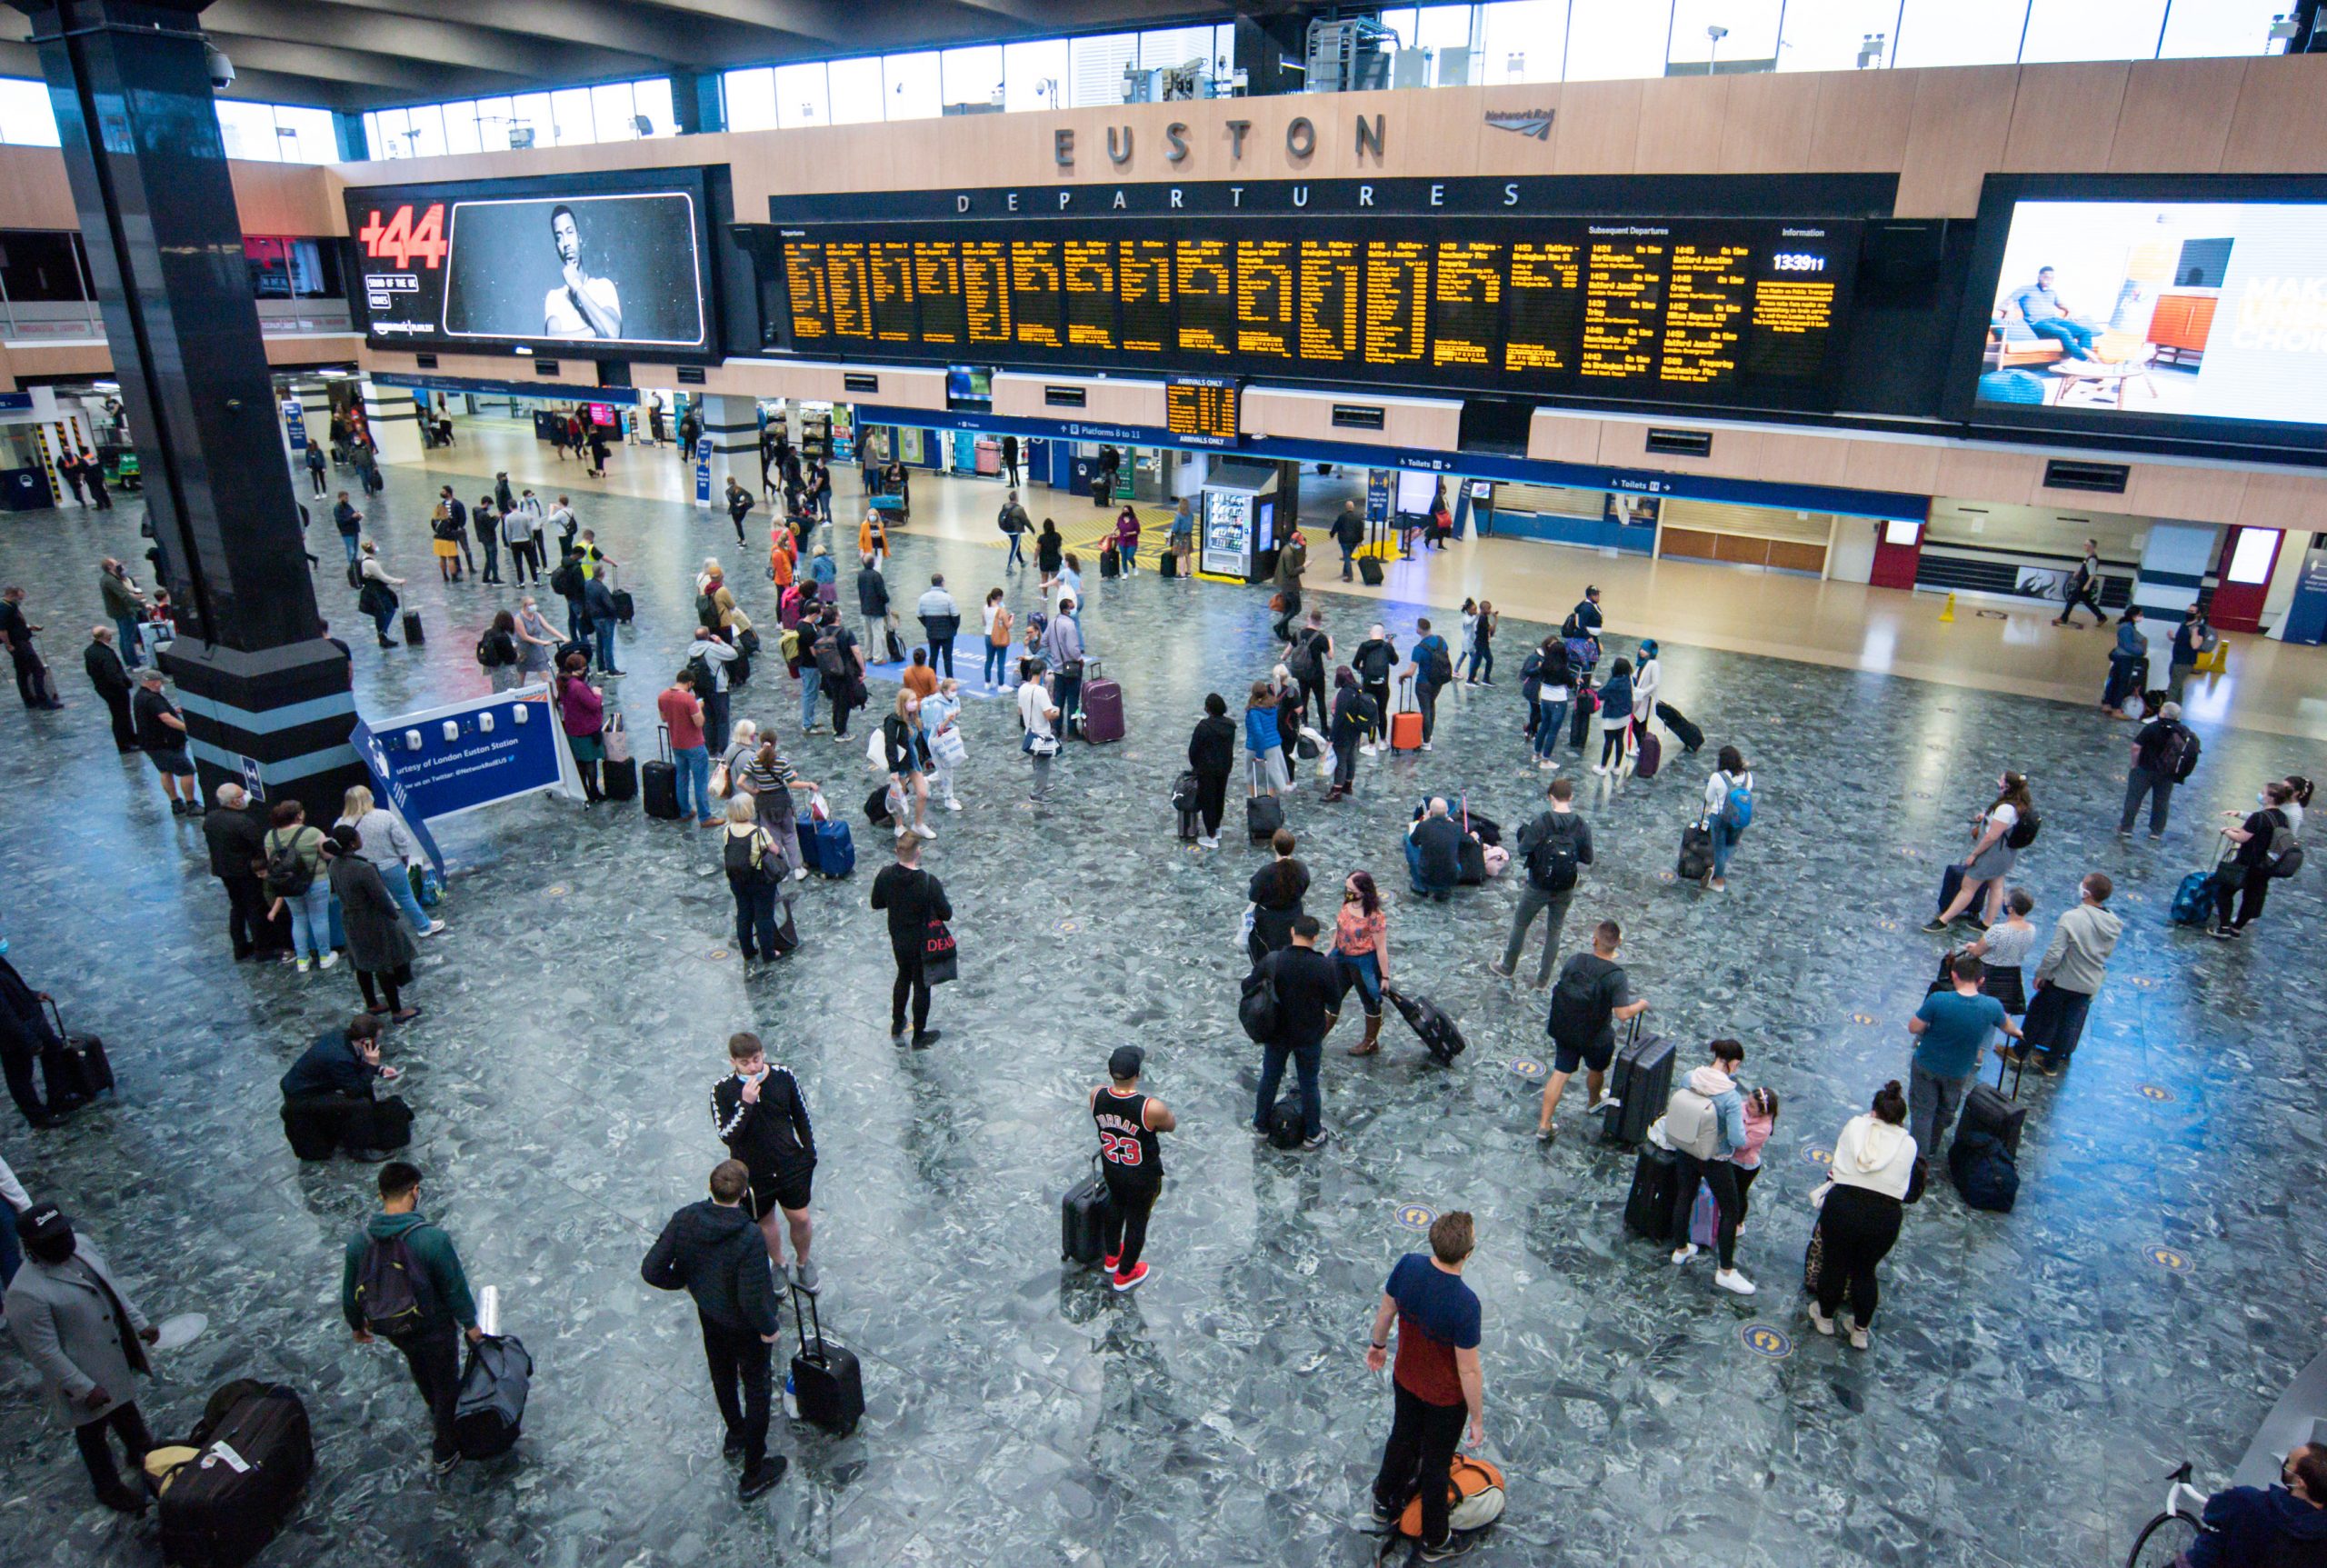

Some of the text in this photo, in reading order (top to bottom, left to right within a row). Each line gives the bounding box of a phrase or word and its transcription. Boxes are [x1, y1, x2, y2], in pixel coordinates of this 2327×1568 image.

[1054, 114, 1385, 165] EUSTON
[958, 183, 1519, 212] DEPARTURES
[1589, 226, 1668, 235] Subsequent Departures
[1783, 228, 1824, 237] Information
[360, 203, 447, 269] +44
[1544, 245, 1573, 253] Platform
[1593, 245, 1663, 254] 1424 On time
[1733, 247, 1749, 255] time
[1644, 274, 1659, 282] time
[1717, 275, 1727, 284] On
[386, 278, 394, 288] OF
[395, 278, 406, 288] THE
[1670, 284, 1693, 292] Crewe
[1630, 301, 1640, 309] On
[1669, 303, 1689, 311] 1452
[1725, 305, 1741, 313] time
[1587, 308, 1604, 317] Tring
[1639, 328, 1653, 336] time
[1711, 332, 1721, 340] On
[1723, 333, 1738, 341] time
[1636, 355, 1651, 364] time
[1081, 427, 1114, 436] Platforms
[1122, 430, 1130, 438] to
[1407, 457, 1431, 469] Toilets
[1621, 479, 1647, 491] Toilets
[396, 737, 518, 775] urtesy of London Euston Station
[1096, 1114, 1140, 1136] JORDAN
[1101, 1131, 1143, 1165] 23
